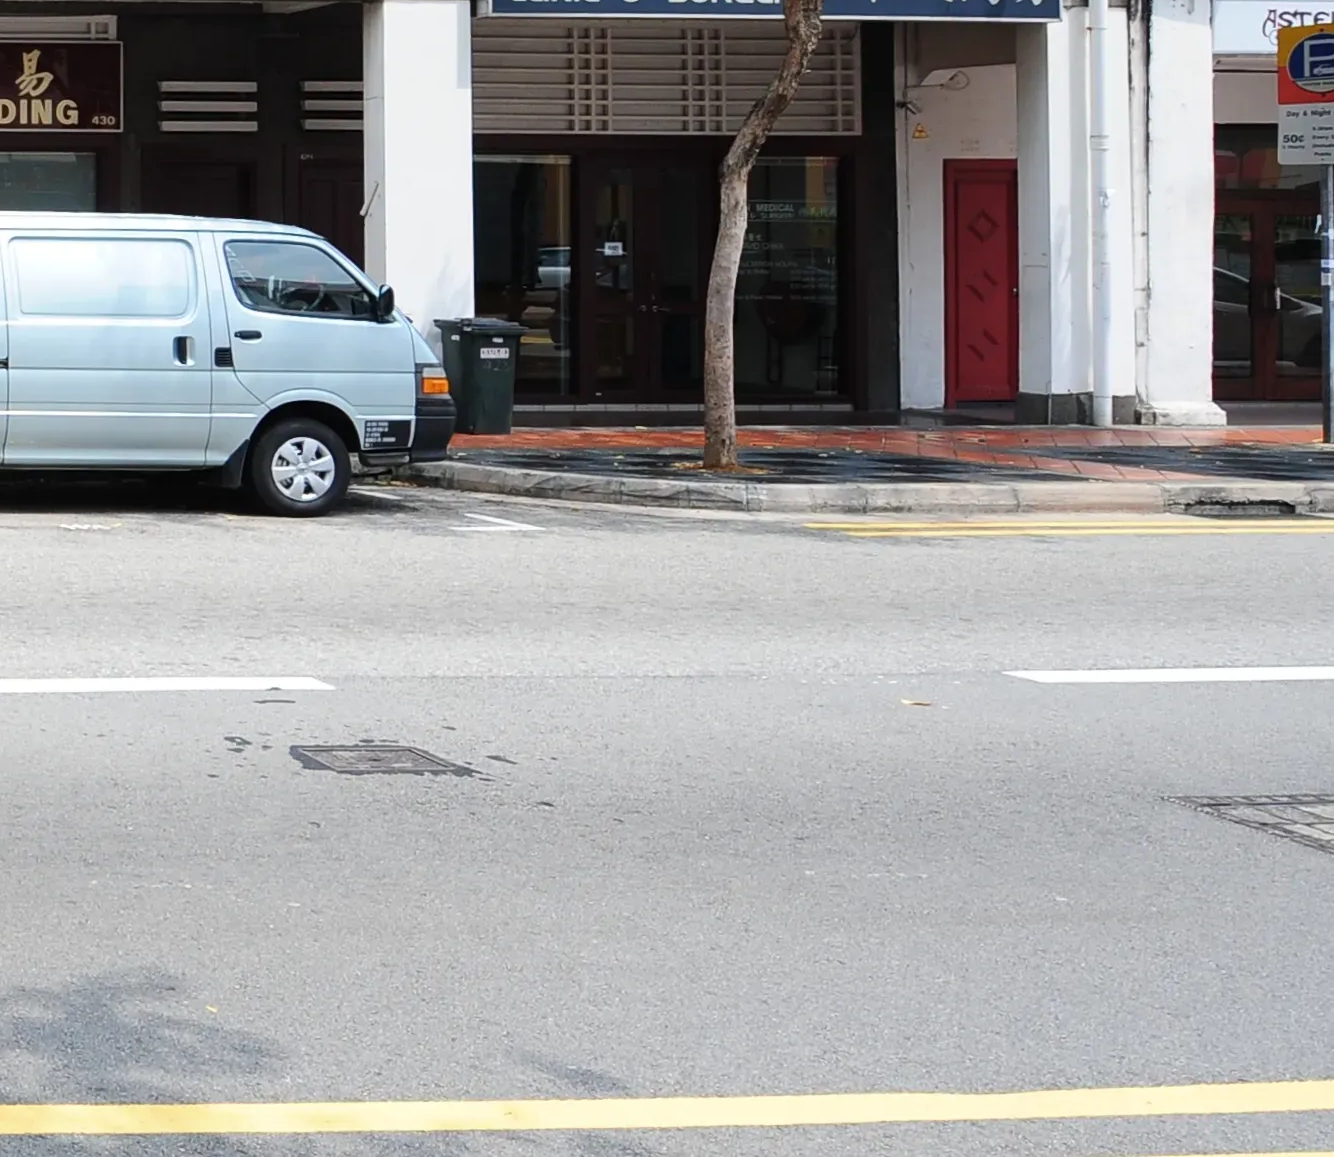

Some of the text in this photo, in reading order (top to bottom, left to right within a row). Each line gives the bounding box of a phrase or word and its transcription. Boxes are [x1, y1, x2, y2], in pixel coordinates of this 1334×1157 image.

[1262, 9, 1334, 38] ASTE
[1285, 110, 1300, 118] Day
[1310, 108, 1331, 117] Night
[91, 116, 116, 125] 430
[1282, 134, 1305, 143] 50¢
